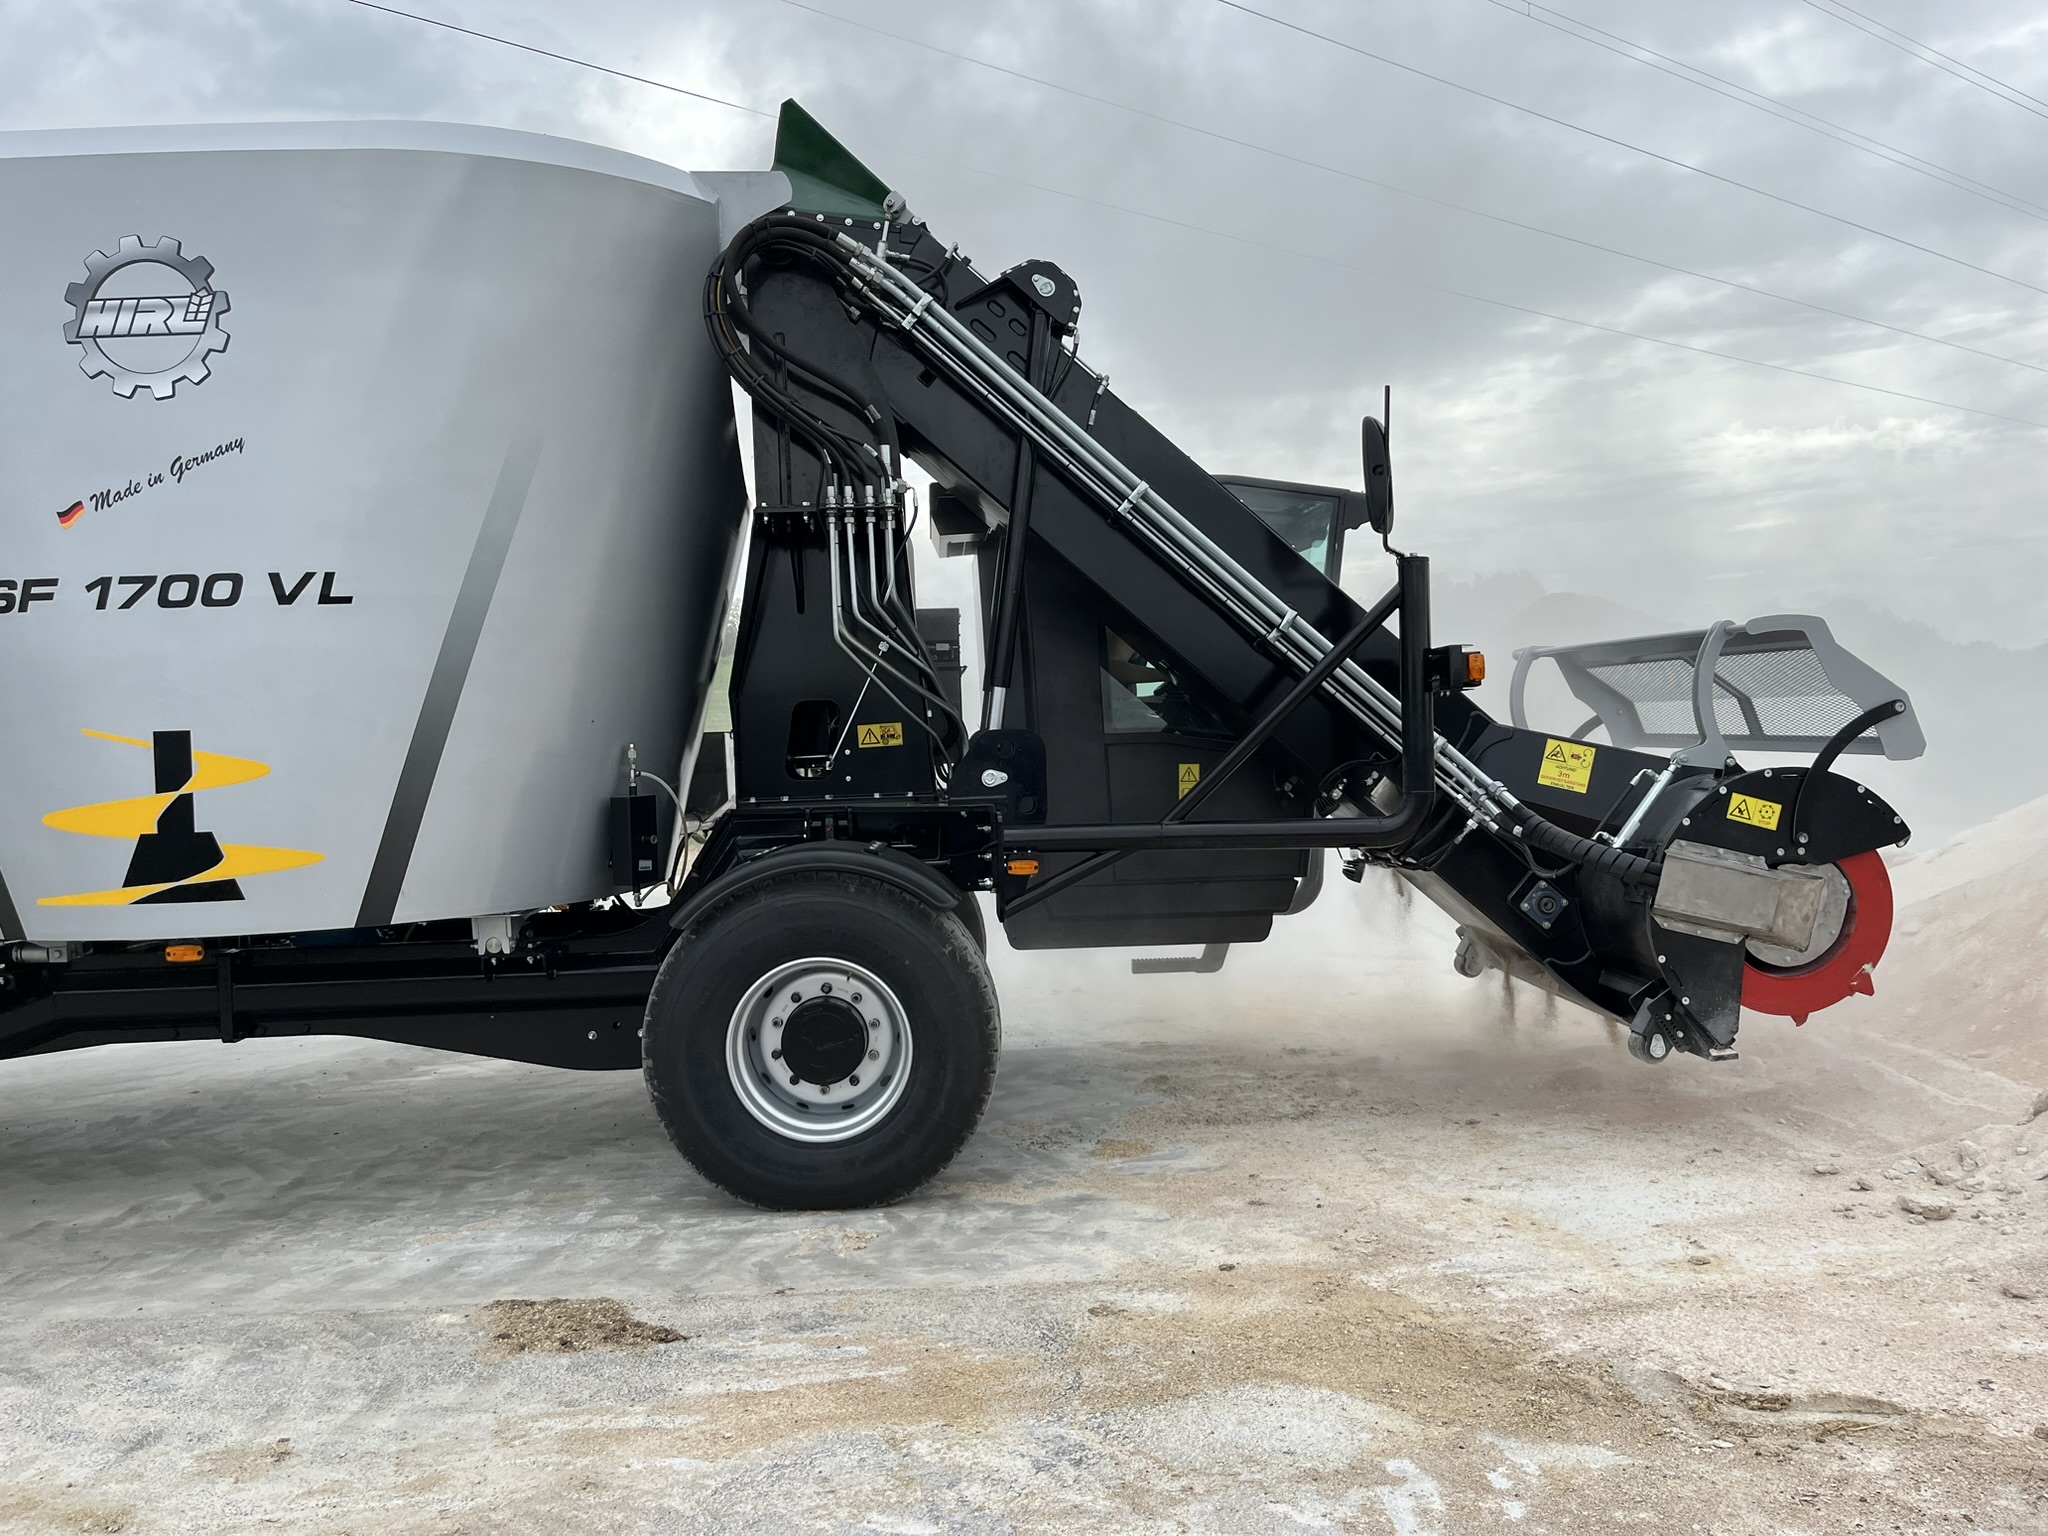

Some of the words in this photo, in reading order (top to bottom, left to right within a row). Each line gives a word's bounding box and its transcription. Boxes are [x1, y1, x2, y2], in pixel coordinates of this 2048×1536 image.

[76, 292, 216, 339] HIRL
[90, 480, 143, 511] Made
[148, 473, 164, 487] in
[170, 437, 245, 483] Germany
[85, 573, 244, 610] 1700
[268, 572, 353, 605] VL
